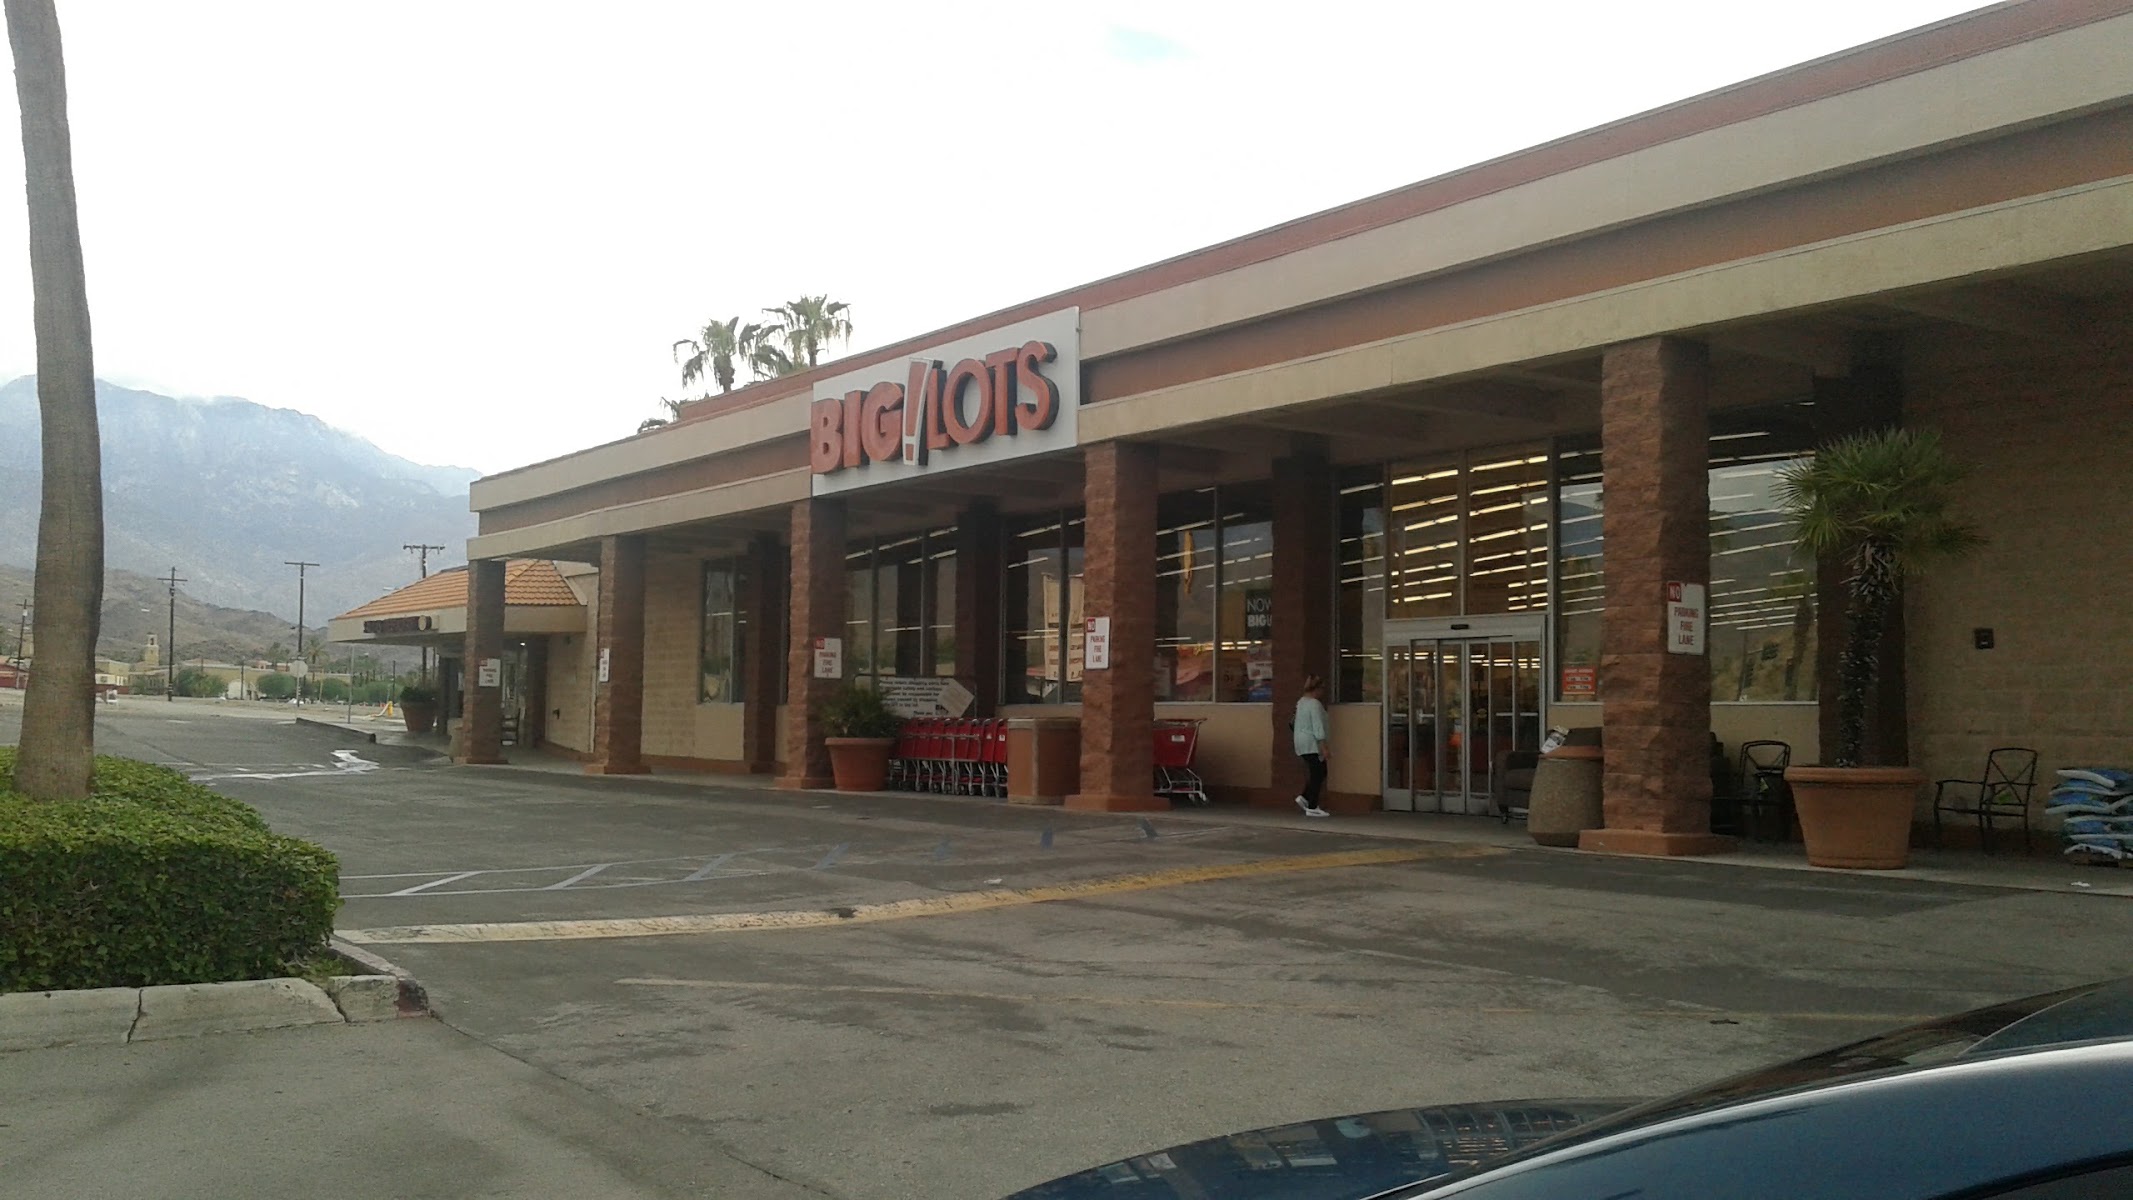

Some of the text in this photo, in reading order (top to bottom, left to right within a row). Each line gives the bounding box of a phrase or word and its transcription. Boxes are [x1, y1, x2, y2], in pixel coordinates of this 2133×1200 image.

[927, 341, 1060, 450] LOTS
[1670, 586, 1681, 599] NO
[1673, 607, 1698, 618] PARKING
[1680, 621, 1693, 632] FIRE
[1678, 635, 1694, 645] LANE
